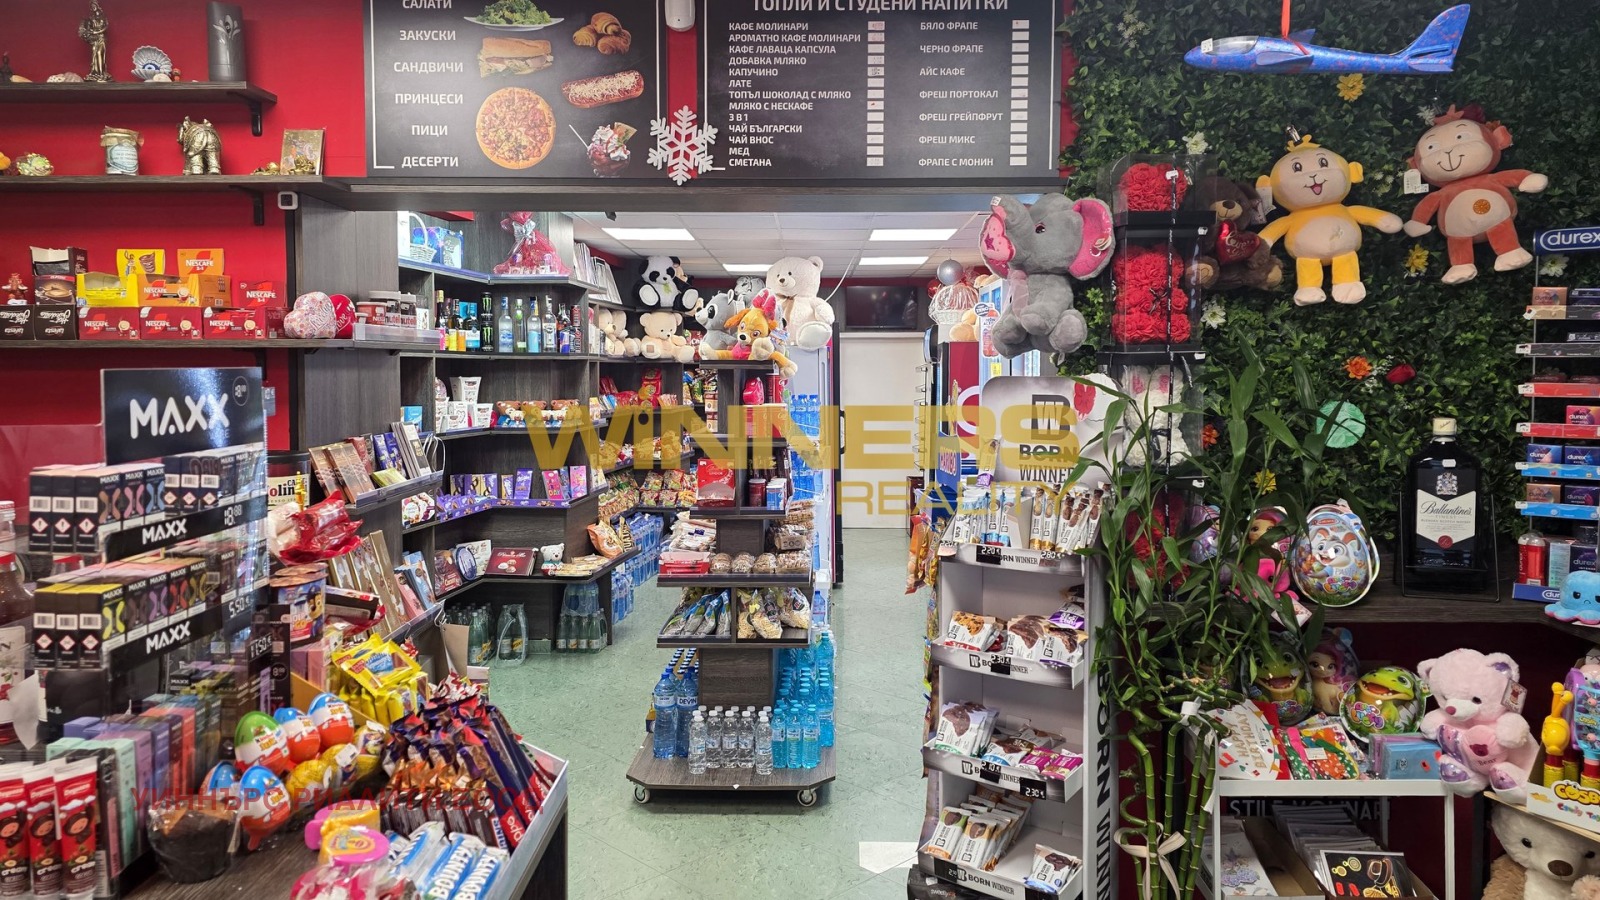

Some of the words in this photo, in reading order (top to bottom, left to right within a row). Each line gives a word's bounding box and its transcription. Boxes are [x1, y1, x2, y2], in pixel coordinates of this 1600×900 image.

[402, 0, 452, 9] САЛАТИ
[754, 0, 813, 11] ТОПЛИ
[817, 0, 830, 11] И
[834, 0, 917, 13] СТУДЕНИ
[921, 0, 1009, 11] НАПИТКИ
[728, 22, 754, 31] КАФЕ
[756, 22, 809, 31] МОЛИНАРИ
[920, 22, 945, 31] БЯЛО
[946, 21, 979, 31] ФРАПЕ
[399, 30, 456, 42] ЗАКУСКИ
[728, 34, 777, 43] АРОМАТНО
[779, 34, 807, 43] КАФЕ
[808, 33, 861, 42] МОЛИНАРИ
[728, 45, 755, 54] КАФЕ
[755, 45, 794, 55] ЛАВАЦА
[795, 45, 837, 54] КАПСУЛА
[920, 44, 951, 53] ЧЕРНО
[952, 44, 984, 53] ФРАПЕ
[728, 56, 772, 66] ДОБАВКА
[773, 56, 807, 65] МЛЯКО
[393, 62, 464, 75] САНДВИЧИ
[728, 67, 779, 77] КАПУЧИНО
[919, 66, 939, 76] АЙС
[940, 67, 966, 76] КАФЕ
[728, 79, 752, 88] ЛАТЕ
[728, 90, 761, 99] ТОПЪЛ
[762, 90, 810, 100] ШОКОЛАД
[811, 90, 817, 99] С
[818, 90, 852, 99] МЛЯКО
[919, 90, 948, 99] ФРЕШ
[949, 89, 999, 99] ПОРТОКАЛ
[395, 93, 464, 107] ПРИНЦЕСИ
[728, 102, 762, 111] МЛЯКО
[763, 102, 770, 111] С
[771, 102, 814, 111] НЕСКАФЕ
[728, 113, 735, 122] 3
[736, 113, 743, 122] В
[744, 113, 749, 122] 1
[918, 112, 948, 121] ФРЕШ
[949, 111, 1004, 121] ГРЕЙПФРУТ
[411, 125, 449, 138] ПИЦИ
[728, 123, 748, 133] ЧАЙ
[749, 124, 803, 133] БЪЛГАРСКИ
[728, 135, 748, 144] ЧАЙ
[749, 135, 774, 144] ВНОС
[918, 135, 948, 144] ФРЕШ
[949, 135, 976, 144] МИКС
[728, 147, 750, 156] МЕД
[401, 156, 460, 169] ДЕСЕРТИ
[728, 158, 772, 167] СМЕТАНА
[918, 157, 949, 167] ФРАПЕ
[950, 157, 958, 166] С
[958, 157, 994, 166] МОНИН
[1547, 231, 1600, 247] durex
[129, 393, 229, 439] MAXX
[1019, 444, 1078, 464] BORN
[1420, 500, 1472, 516] Ballantine's
[142, 518, 187, 545] MAXX
[1015, 556, 1038, 565] WINNER
[146, 621, 191, 654] MAXX
[1097, 664, 1110, 808] BORN
[1554, 783, 1600, 806] COSB
[1230, 800, 1281, 817] STIL
[428, 846, 473, 899] BOUNTY
[455, 853, 499, 900] BOUNTY
[968, 873, 991, 888] BORN
[991, 880, 1015, 895] WINNER
